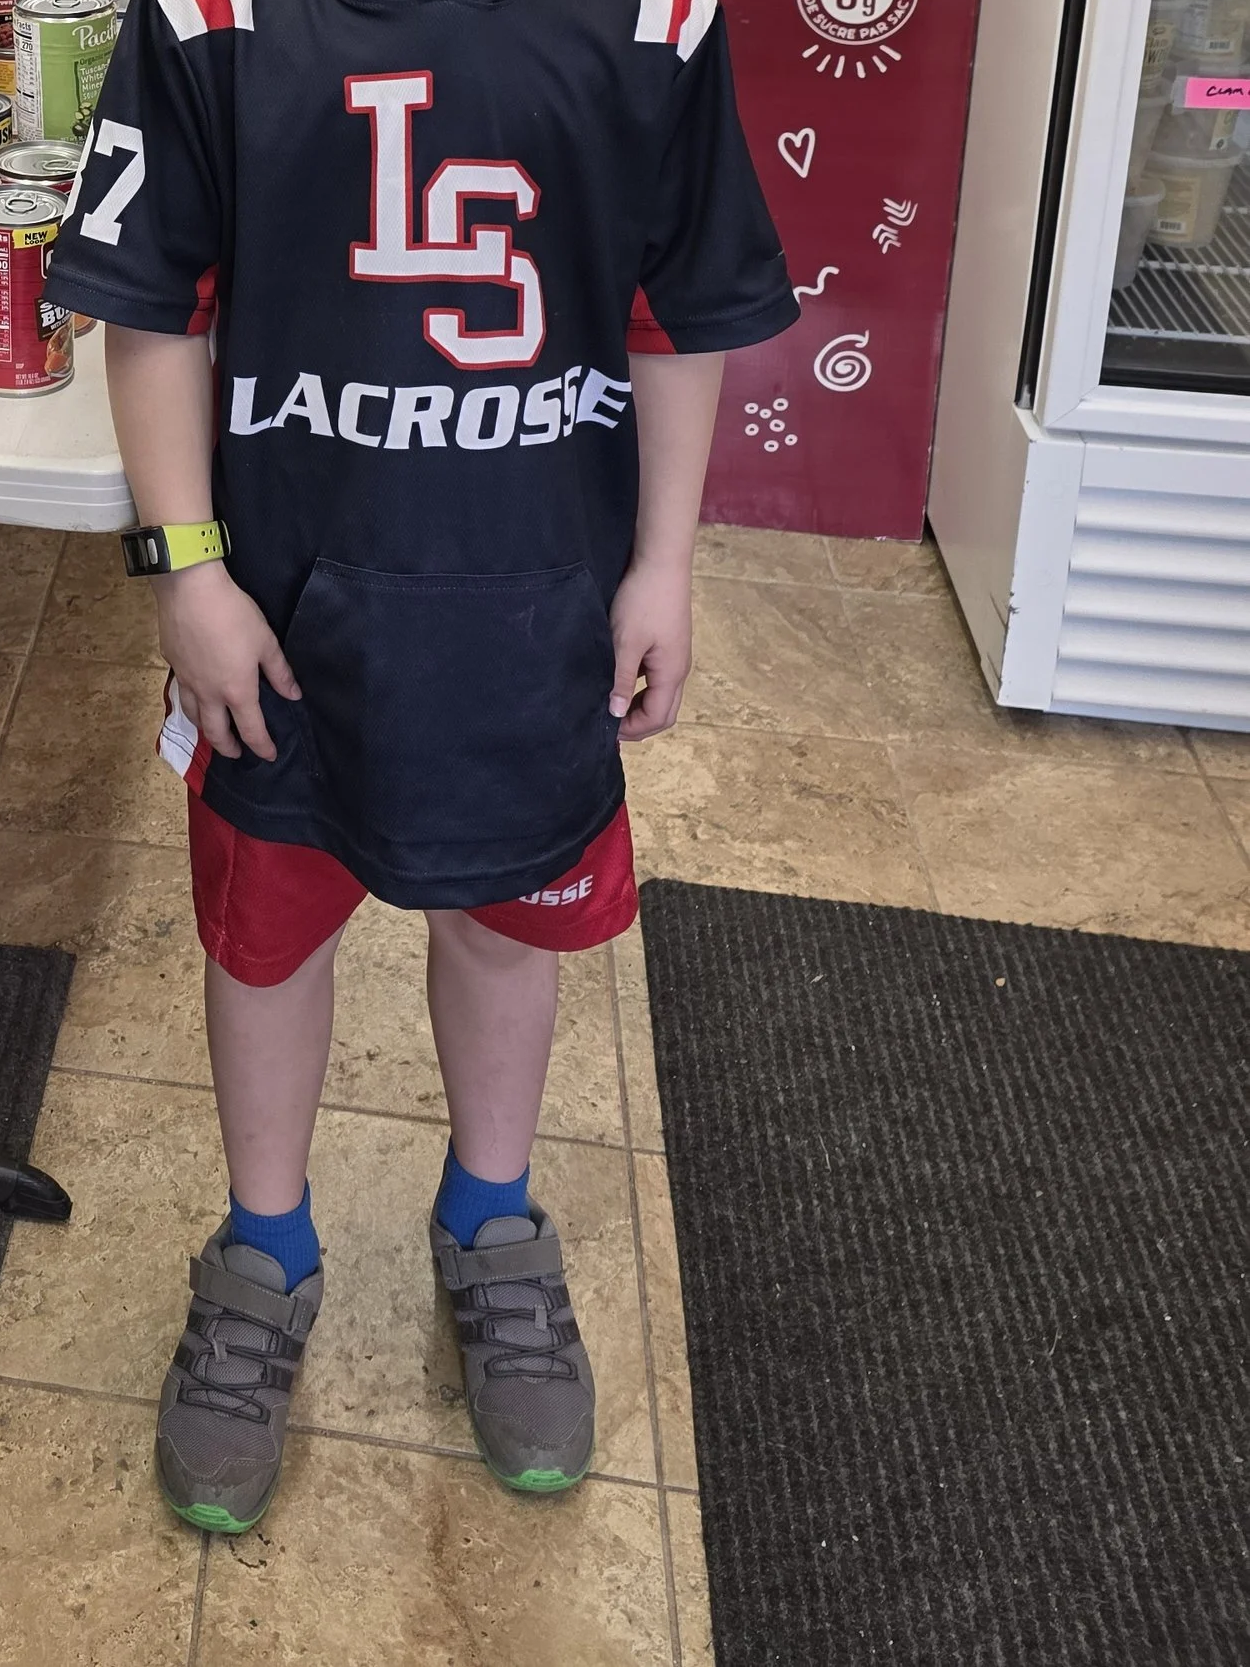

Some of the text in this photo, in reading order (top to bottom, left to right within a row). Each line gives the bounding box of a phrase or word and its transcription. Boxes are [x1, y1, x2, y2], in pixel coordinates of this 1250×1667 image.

[812, 13, 857, 40] SUCRE
[859, 21, 889, 40] PAR
[887, 0, 910, 25] SAC
[80, 71, 104, 84] White
[1205, 85, 1245, 97] CLAM
[62, 117, 146, 246] 7
[24, 231, 49, 241] NEW
[228, 364, 634, 451] LACROSSE
